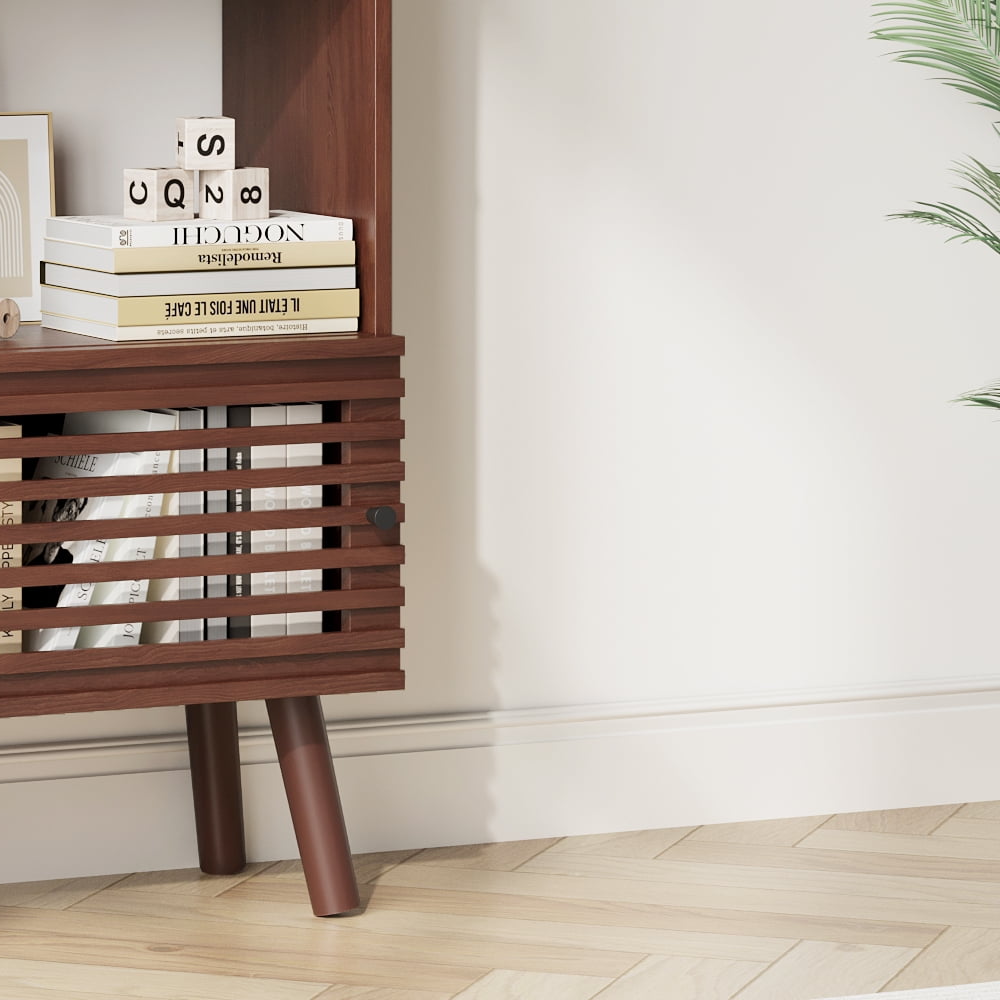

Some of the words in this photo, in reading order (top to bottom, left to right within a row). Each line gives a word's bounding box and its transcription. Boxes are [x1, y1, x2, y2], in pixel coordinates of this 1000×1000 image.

[197, 133, 225, 157] S
[129, 181, 148, 205] C
[164, 178, 186, 209] Q
[205, 184, 224, 204] 2
[240, 185, 262, 204] 8
[172, 223, 305, 246] NOGUCHI
[198, 251, 282, 266] Remodelista
[164, 302, 191, 320] CAFÉ
[194, 301, 207, 316] LE
[210, 300, 233, 315] FOIS
[235, 299, 256, 315] UNE
[258, 298, 288, 316] ÉTAIT
[290, 297, 300, 312] IL
